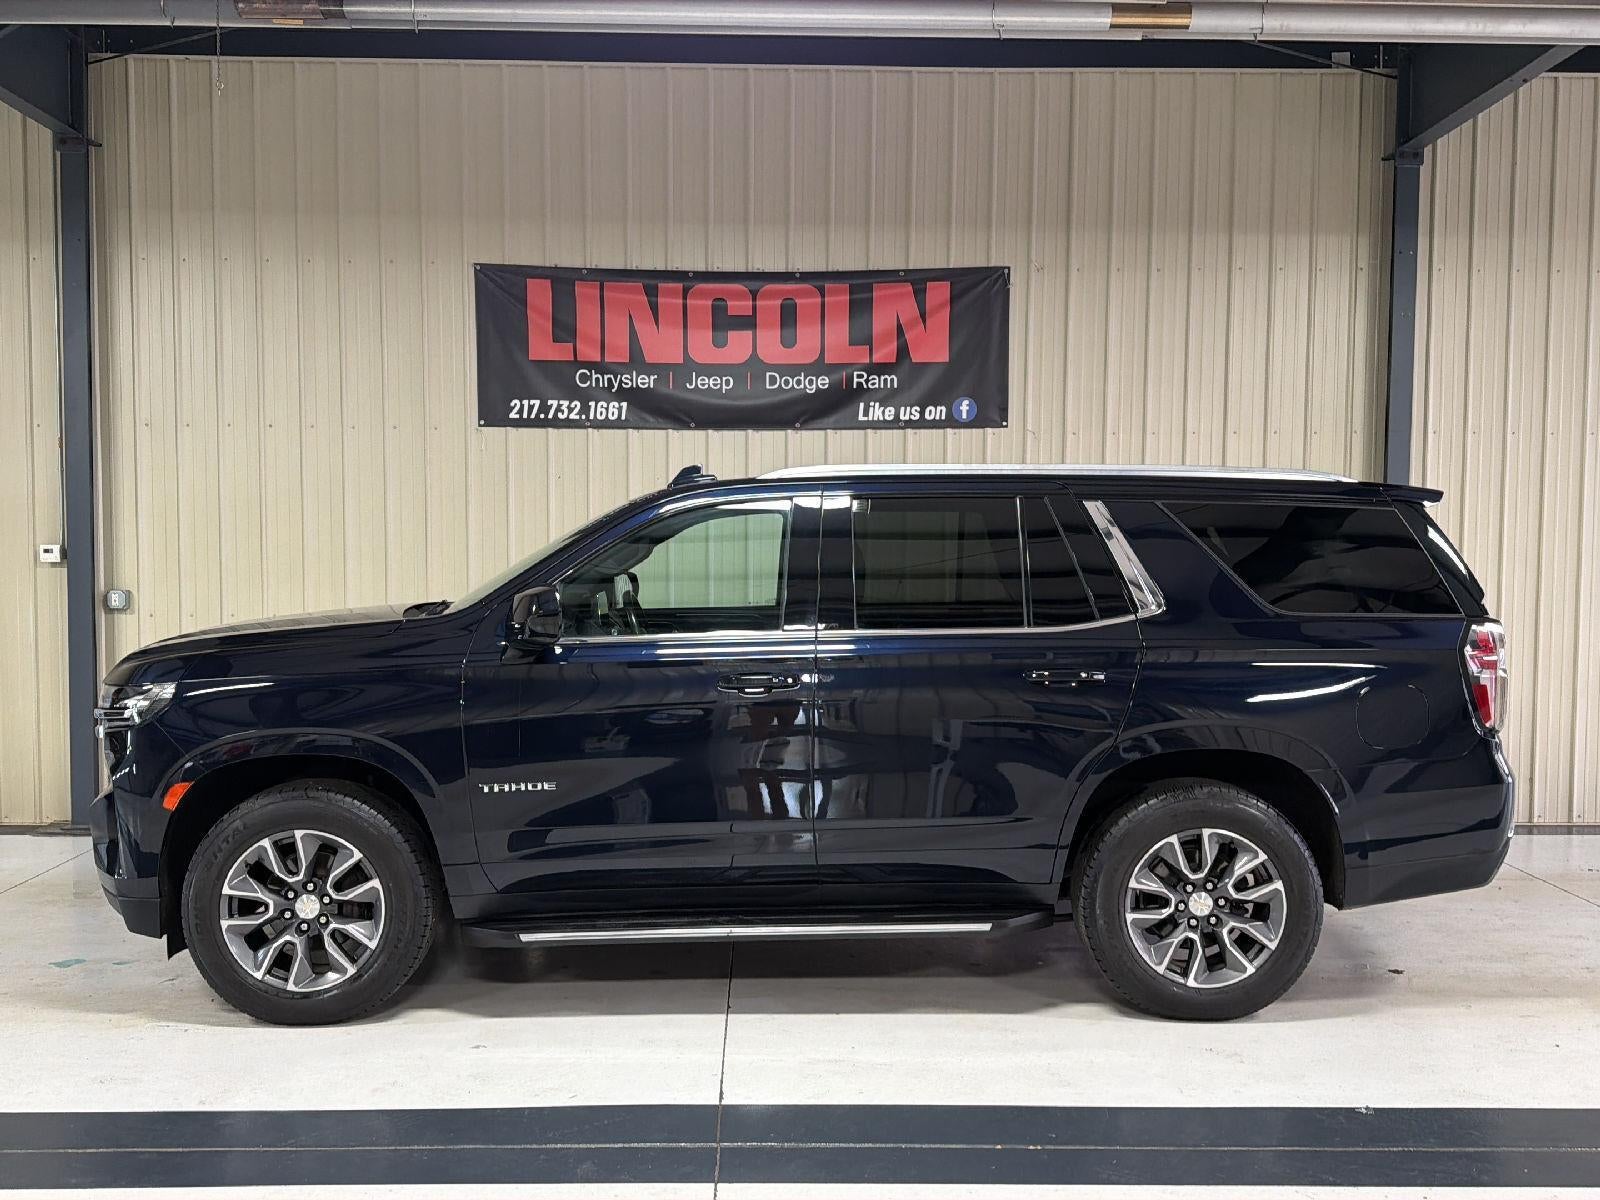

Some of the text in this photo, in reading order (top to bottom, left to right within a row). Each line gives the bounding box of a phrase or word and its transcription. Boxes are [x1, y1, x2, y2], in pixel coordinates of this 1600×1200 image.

[526, 278, 950, 364] LINCOLN
[575, 369, 898, 394] Chrysler Jeep Dodge Ram
[508, 399, 628, 421] 217.732.1661
[858, 402, 896, 421] Like
[899, 405, 920, 421] us
[924, 405, 947, 421] on
[478, 781, 557, 793] TAHOE
